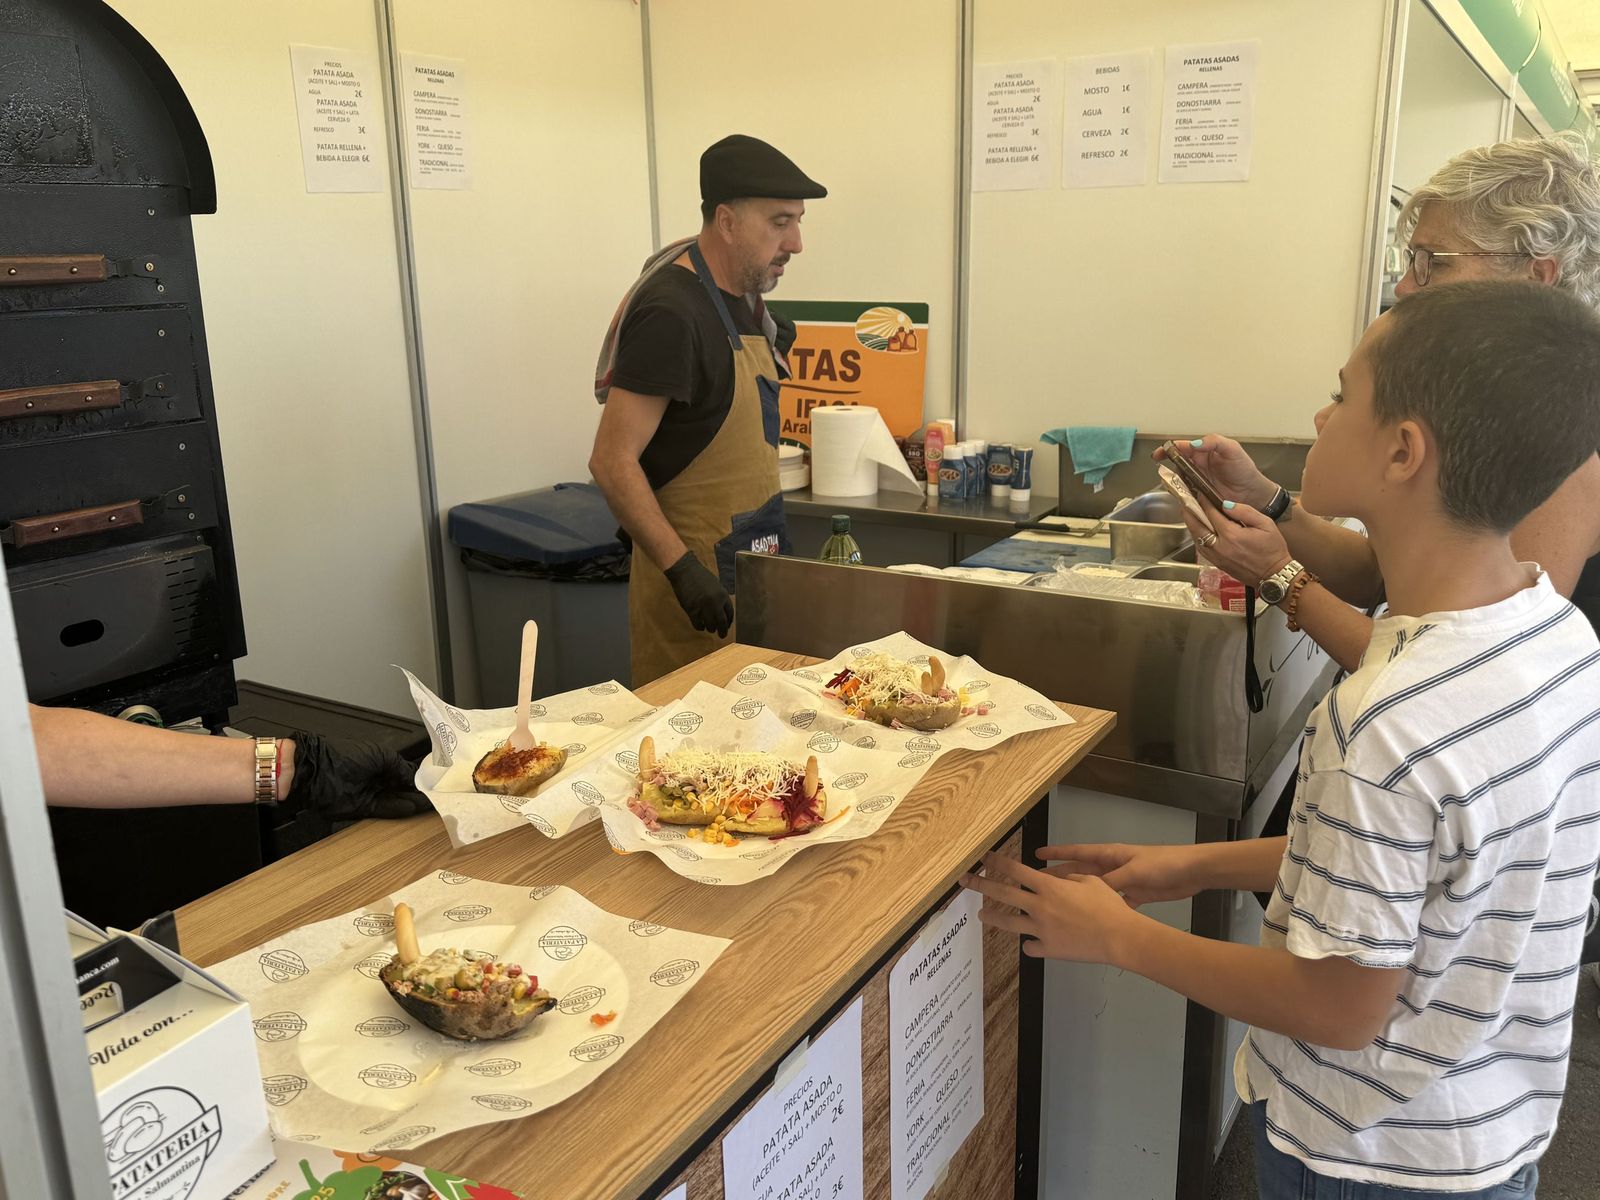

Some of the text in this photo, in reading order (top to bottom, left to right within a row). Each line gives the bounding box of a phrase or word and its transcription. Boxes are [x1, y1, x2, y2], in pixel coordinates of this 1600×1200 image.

[415, 67, 454, 78] PATATAS ASADAS
[1095, 66, 1120, 74] BEBIDAS
[1184, 57, 1212, 65] PATATAS
[413, 90, 436, 98] CAMPERA
[1084, 84, 1130, 95] MOSTO 1€
[1178, 82, 1208, 91] CAMPERA
[415, 108, 447, 116] DONOSTIARRA
[1082, 108, 1102, 116] AGUA
[1177, 99, 1221, 108] DONOSTIARRA
[358, 126, 365, 134] 3€
[1082, 129, 1112, 138] CERVEZA
[419, 159, 449, 167] TRADICIONAL
[1081, 149, 1128, 159] REFRESCO 2€
[1174, 152, 1214, 160] TRADICIONAL
[788, 347, 861, 383] TAS
[909, 943, 941, 986] PATATAS
[941, 913, 967, 949] ASADAS
[262, 958, 296, 973] PATATERIA
[927, 948, 952, 981] RELLENAS
[905, 994, 939, 1039] CAMPERA
[906, 1010, 953, 1075] DONOSTIARRA
[783, 1076, 813, 1114] PRECIOS
[906, 1079, 925, 1109] FERIA
[906, 1111, 924, 1141] YORK
[936, 1068, 958, 1102] QUESO
[763, 1075, 833, 1159] PATATA ASADA
[832, 1099, 844, 1124] 2€
[752, 1151, 781, 1191] (ACEITE
[782, 1144, 787, 1155] Y
[788, 1127, 803, 1150] SAL)
[811, 1090, 836, 1125] MOSTO
[837, 1083, 842, 1095] O
[907, 1112, 950, 1174] TRADICIONAL
[805, 1137, 834, 1179] ASADA
[820, 1153, 836, 1176] LATA
[145, 1155, 201, 1198] Salmantina
[832, 1175, 844, 1200] 3€
